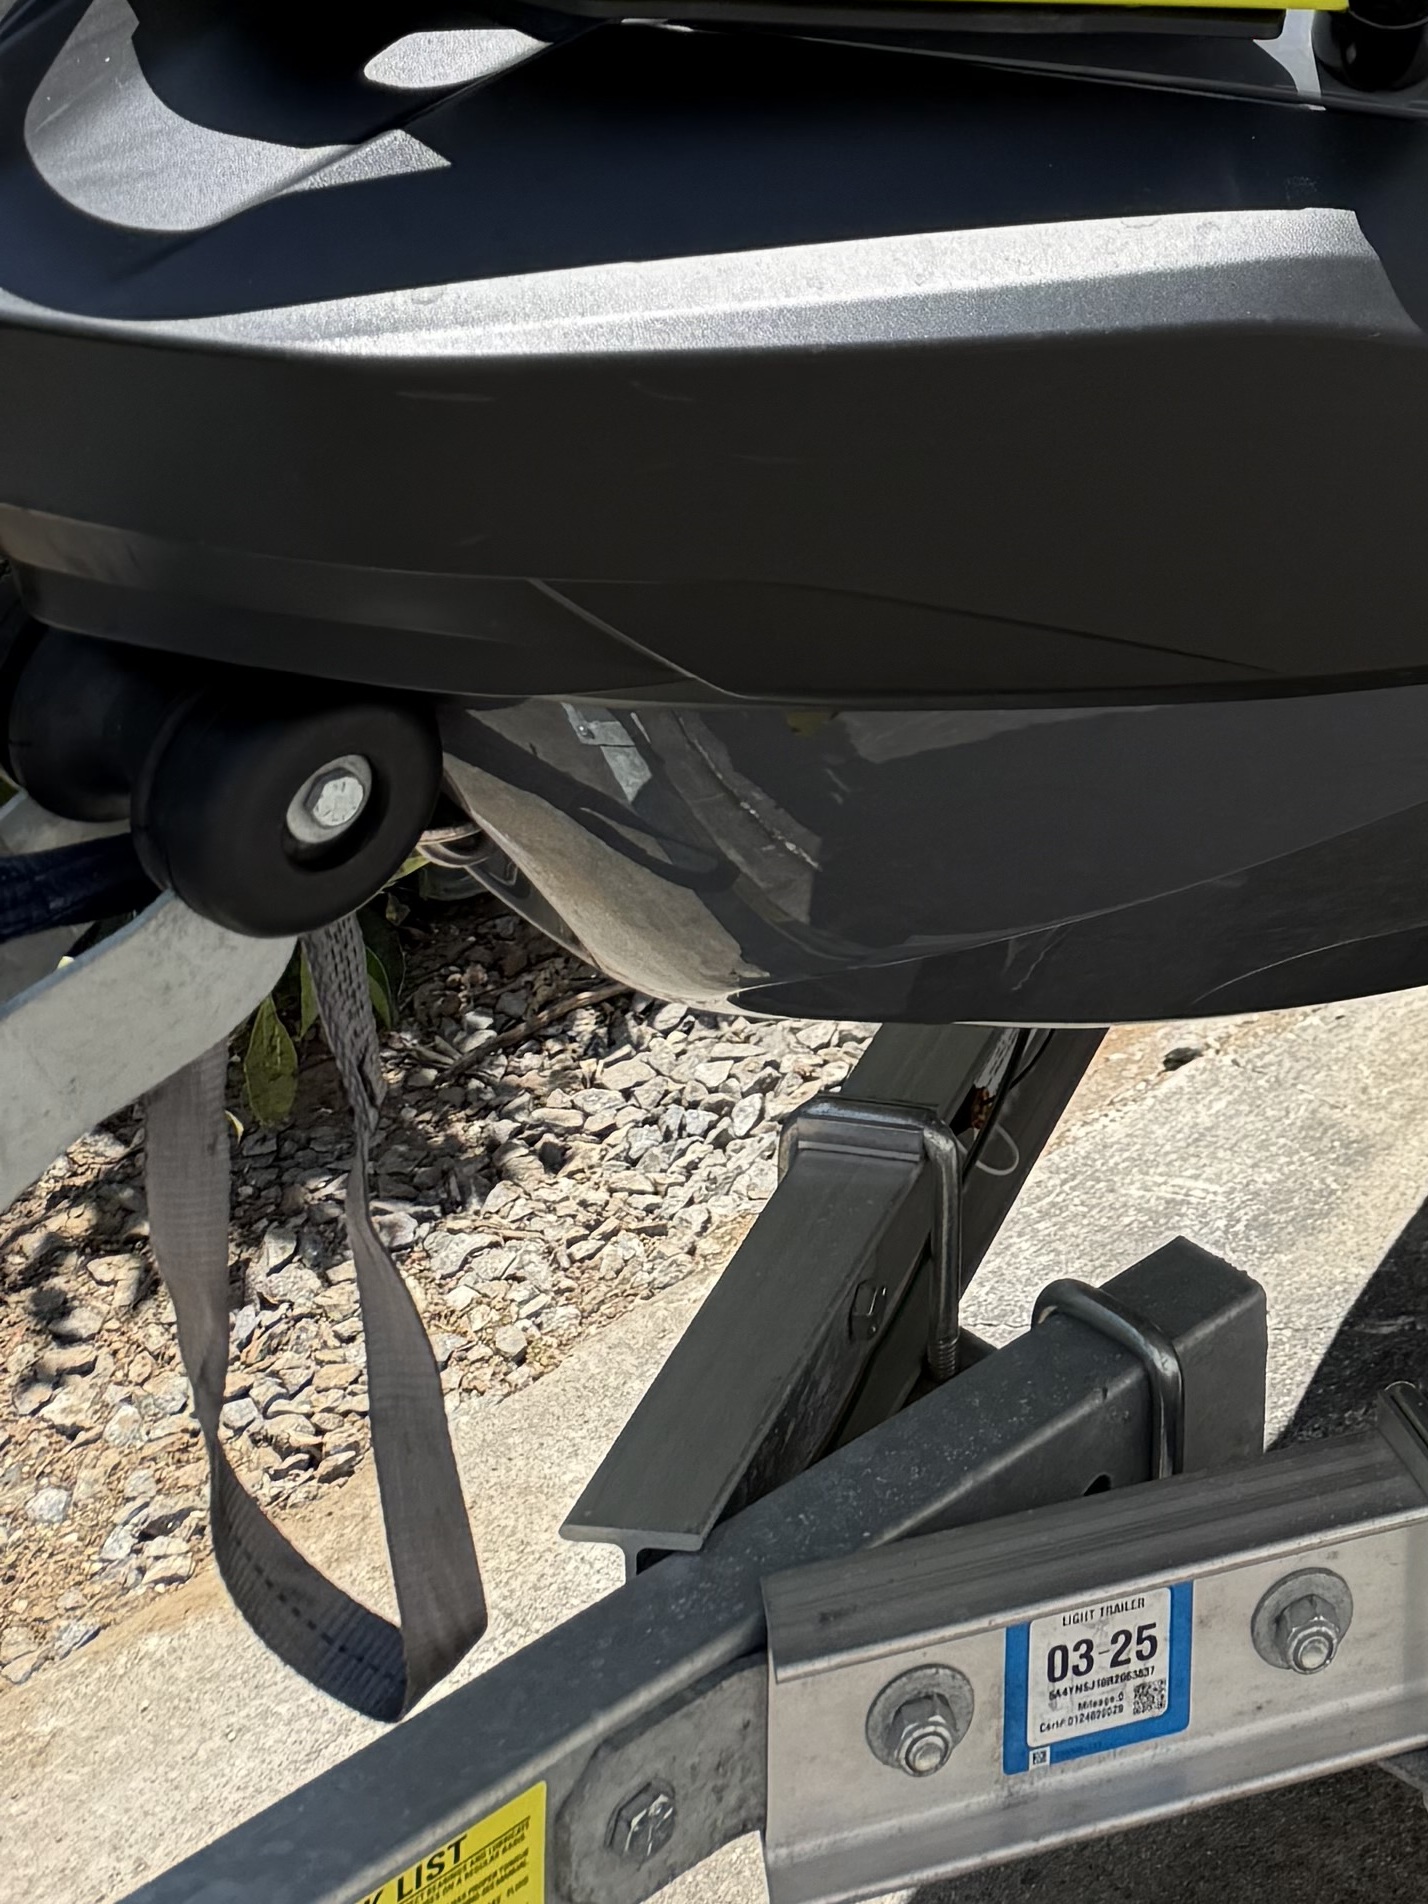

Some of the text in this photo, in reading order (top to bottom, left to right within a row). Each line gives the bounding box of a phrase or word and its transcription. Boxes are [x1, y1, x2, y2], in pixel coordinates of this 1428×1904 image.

[1063, 1597, 1146, 1627] LIGHT TRAILER
[1047, 1622, 1158, 1683] 03-25
[397, 1833, 468, 1902] LIST
